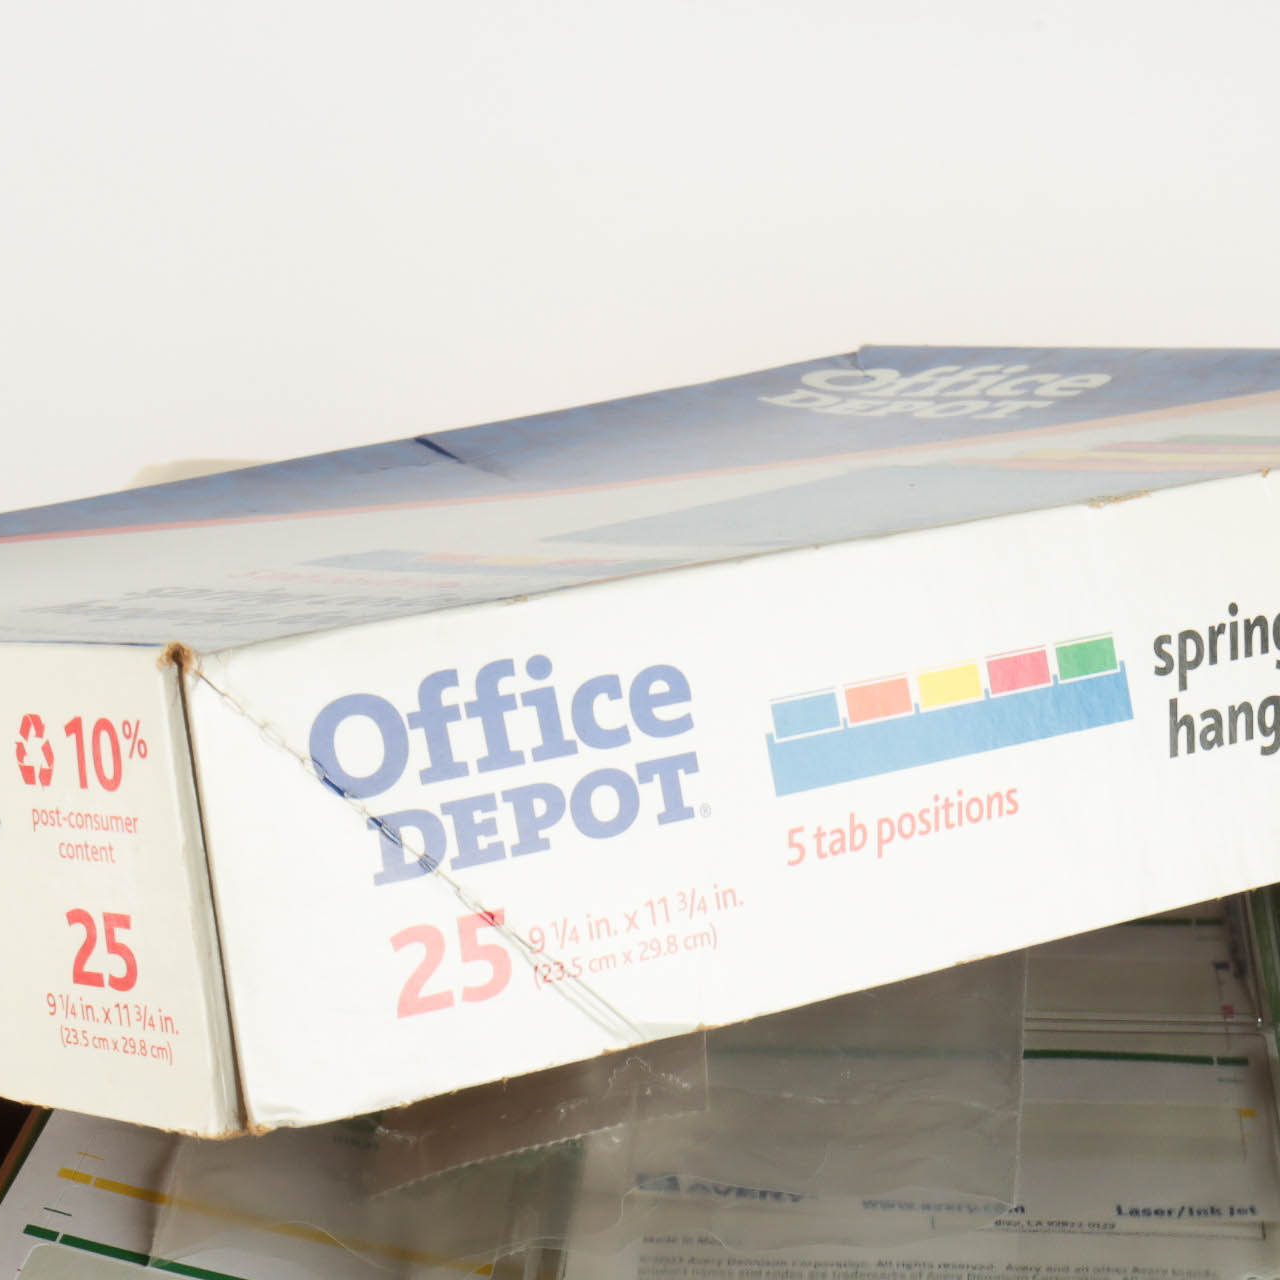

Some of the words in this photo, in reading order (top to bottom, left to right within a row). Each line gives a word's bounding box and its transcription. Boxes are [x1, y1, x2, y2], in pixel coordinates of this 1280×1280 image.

[800, 364, 1112, 398] Office
[64, 715, 148, 792] 10%
[309, 654, 695, 799] Office
[32, 806, 139, 835] post-consumer
[786, 827, 806, 866] 5
[813, 811, 868, 860] tab
[876, 783, 1020, 857] positions
[59, 840, 116, 864] content
[529, 925, 545, 953] 9
[588, 912, 618, 941] in.
[624, 911, 639, 931] x
[644, 898, 671, 926] 11
[713, 883, 744, 911] in.
[66, 908, 138, 992] 25
[389, 908, 513, 1018] 25
[588, 950, 617, 973] cm
[621, 948, 633, 964] x
[638, 933, 679, 962] 29.8
[683, 925, 718, 953] cm)
[47, 992, 56, 1016] 9
[81, 1003, 100, 1023] in.
[103, 1007, 111, 1024] x
[115, 1003, 131, 1028] 11
[158, 1009, 180, 1036] in.
[60, 1025, 89, 1048] (23.5
[92, 1035, 109, 1051] cm
[112, 1038, 119, 1052] x
[121, 1034, 147, 1057] 29.8
[151, 1041, 173, 1066] cm)
